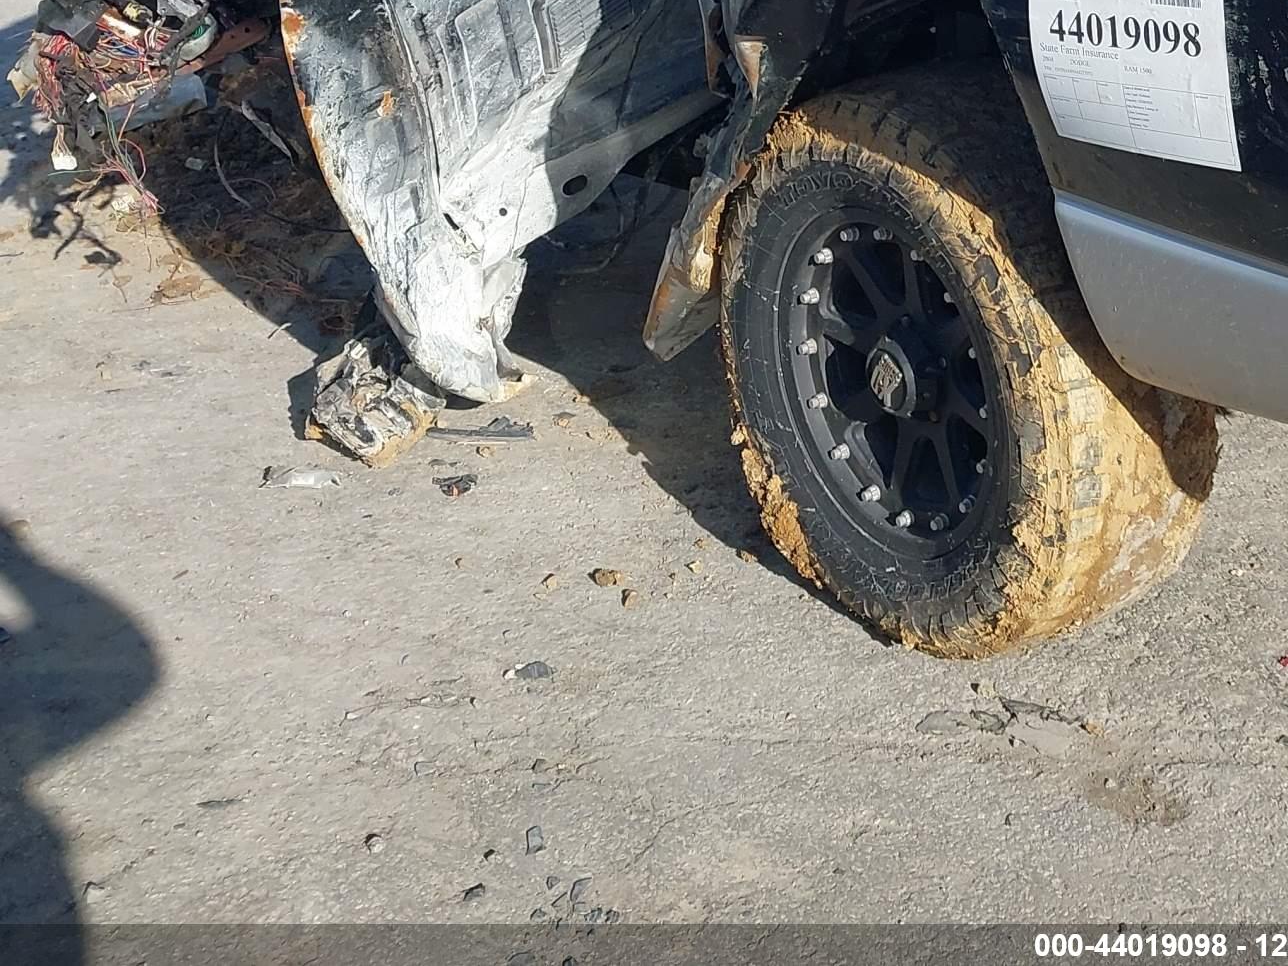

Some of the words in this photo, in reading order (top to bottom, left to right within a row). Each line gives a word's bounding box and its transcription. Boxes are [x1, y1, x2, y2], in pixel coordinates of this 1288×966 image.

[1049, 9, 1202, 57] 44019098
[1039, 42, 1059, 53] State
[1060, 44, 1081, 55] Farm
[1082, 46, 1119, 60] Insurance
